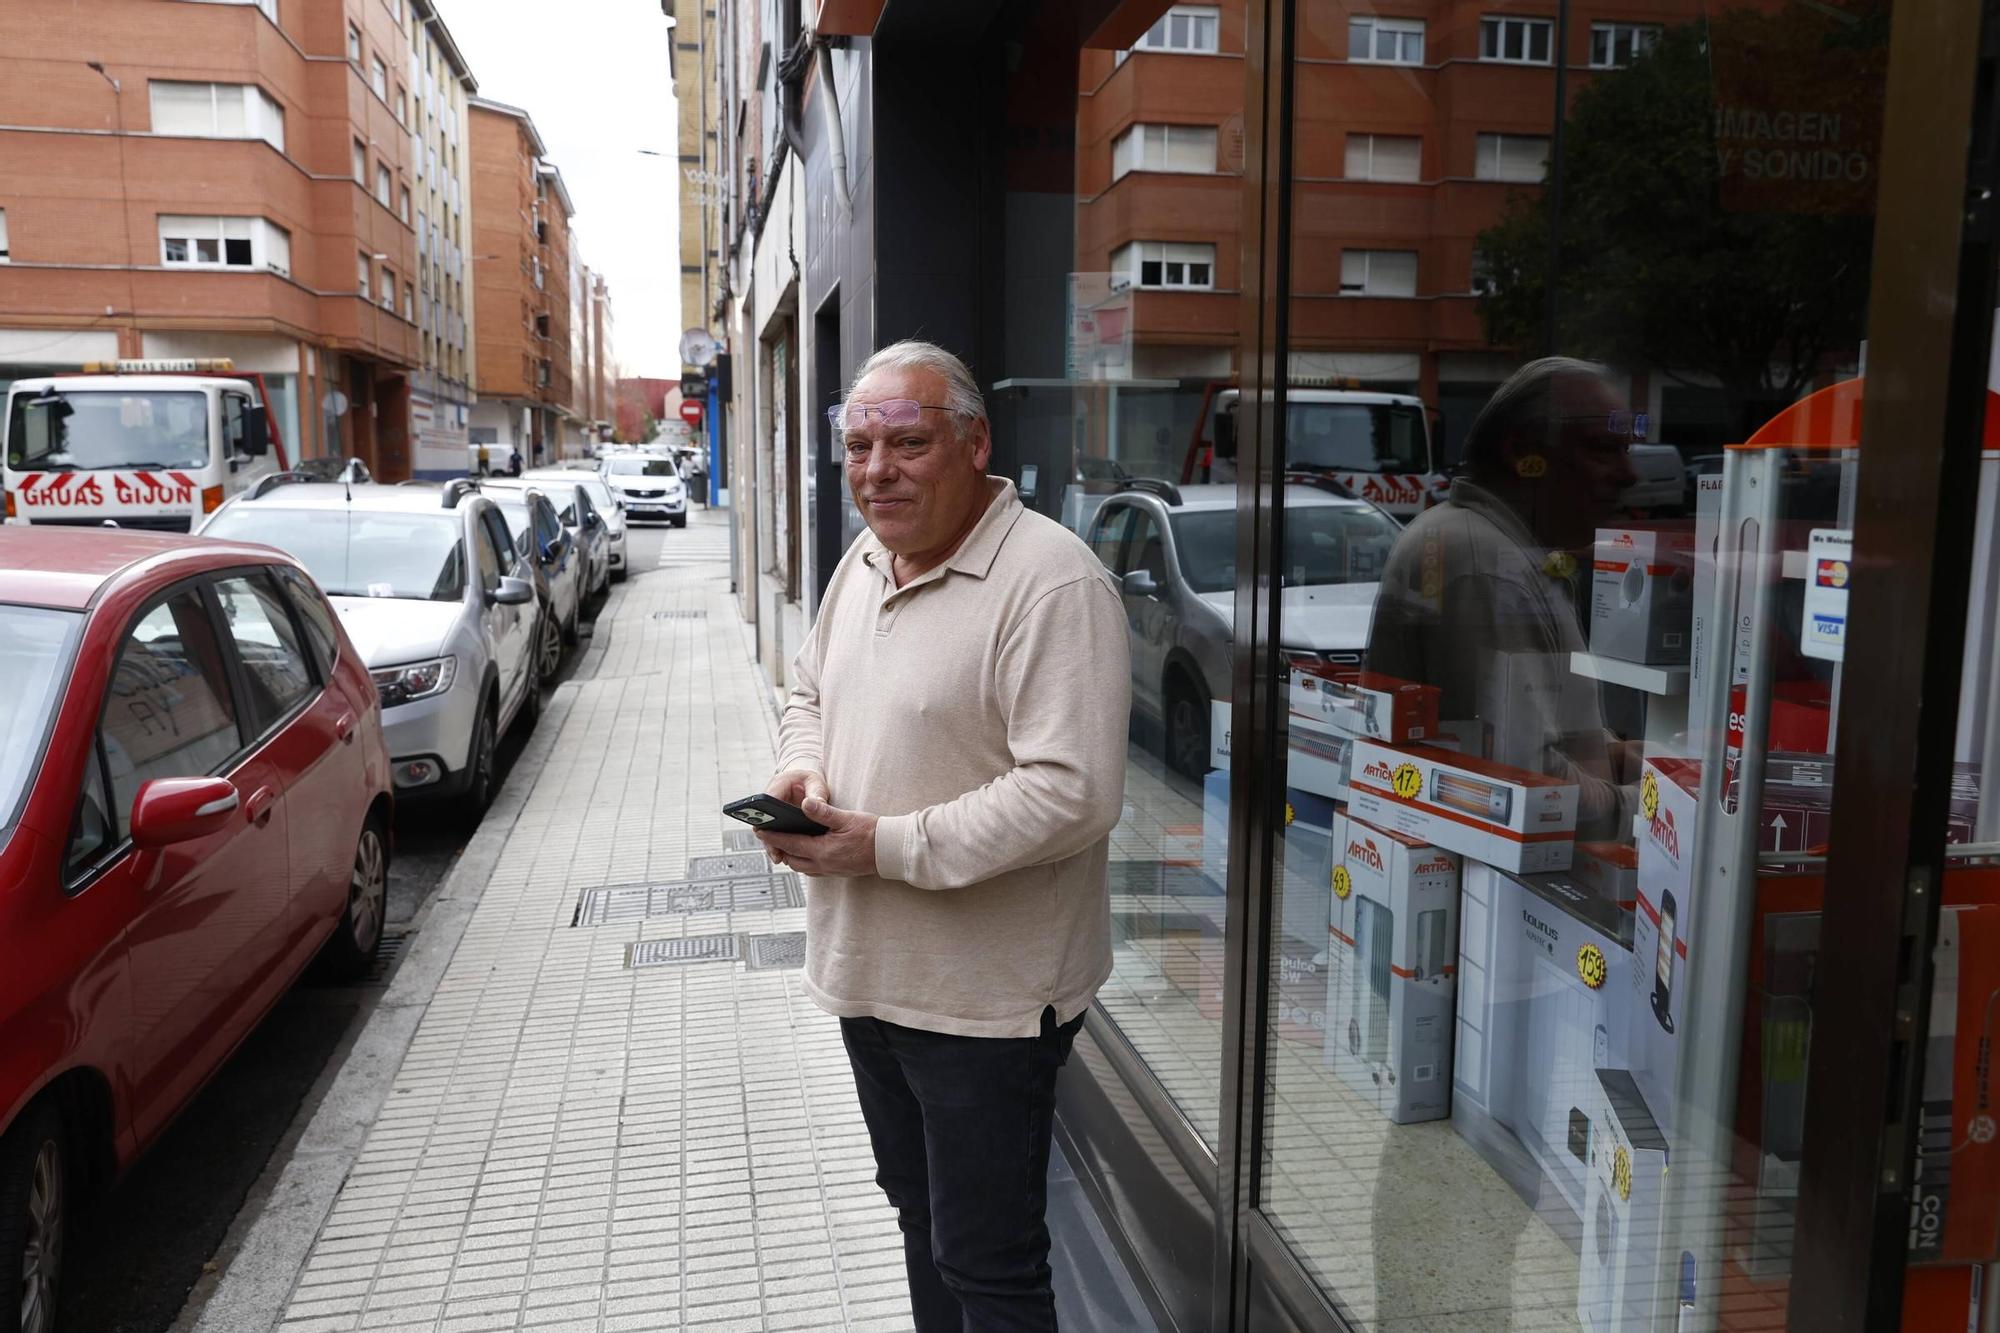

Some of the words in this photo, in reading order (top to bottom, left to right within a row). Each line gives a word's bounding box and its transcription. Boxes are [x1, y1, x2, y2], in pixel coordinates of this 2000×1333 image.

[1714, 109, 1841, 143] IMAGEN
[1716, 149, 1731, 177] Y
[1743, 149, 1869, 182] SONIDO
[24, 486, 104, 506] GRUAS
[116, 486, 192, 505] GIJON
[1817, 622, 1840, 636] VISA
[1651, 817, 1679, 860] ARTICA
[1347, 840, 1385, 872] ARTICA
[1414, 860, 1456, 875] ARTICA
[1522, 909, 1559, 941] taurus
[1580, 948, 1602, 982] 159
